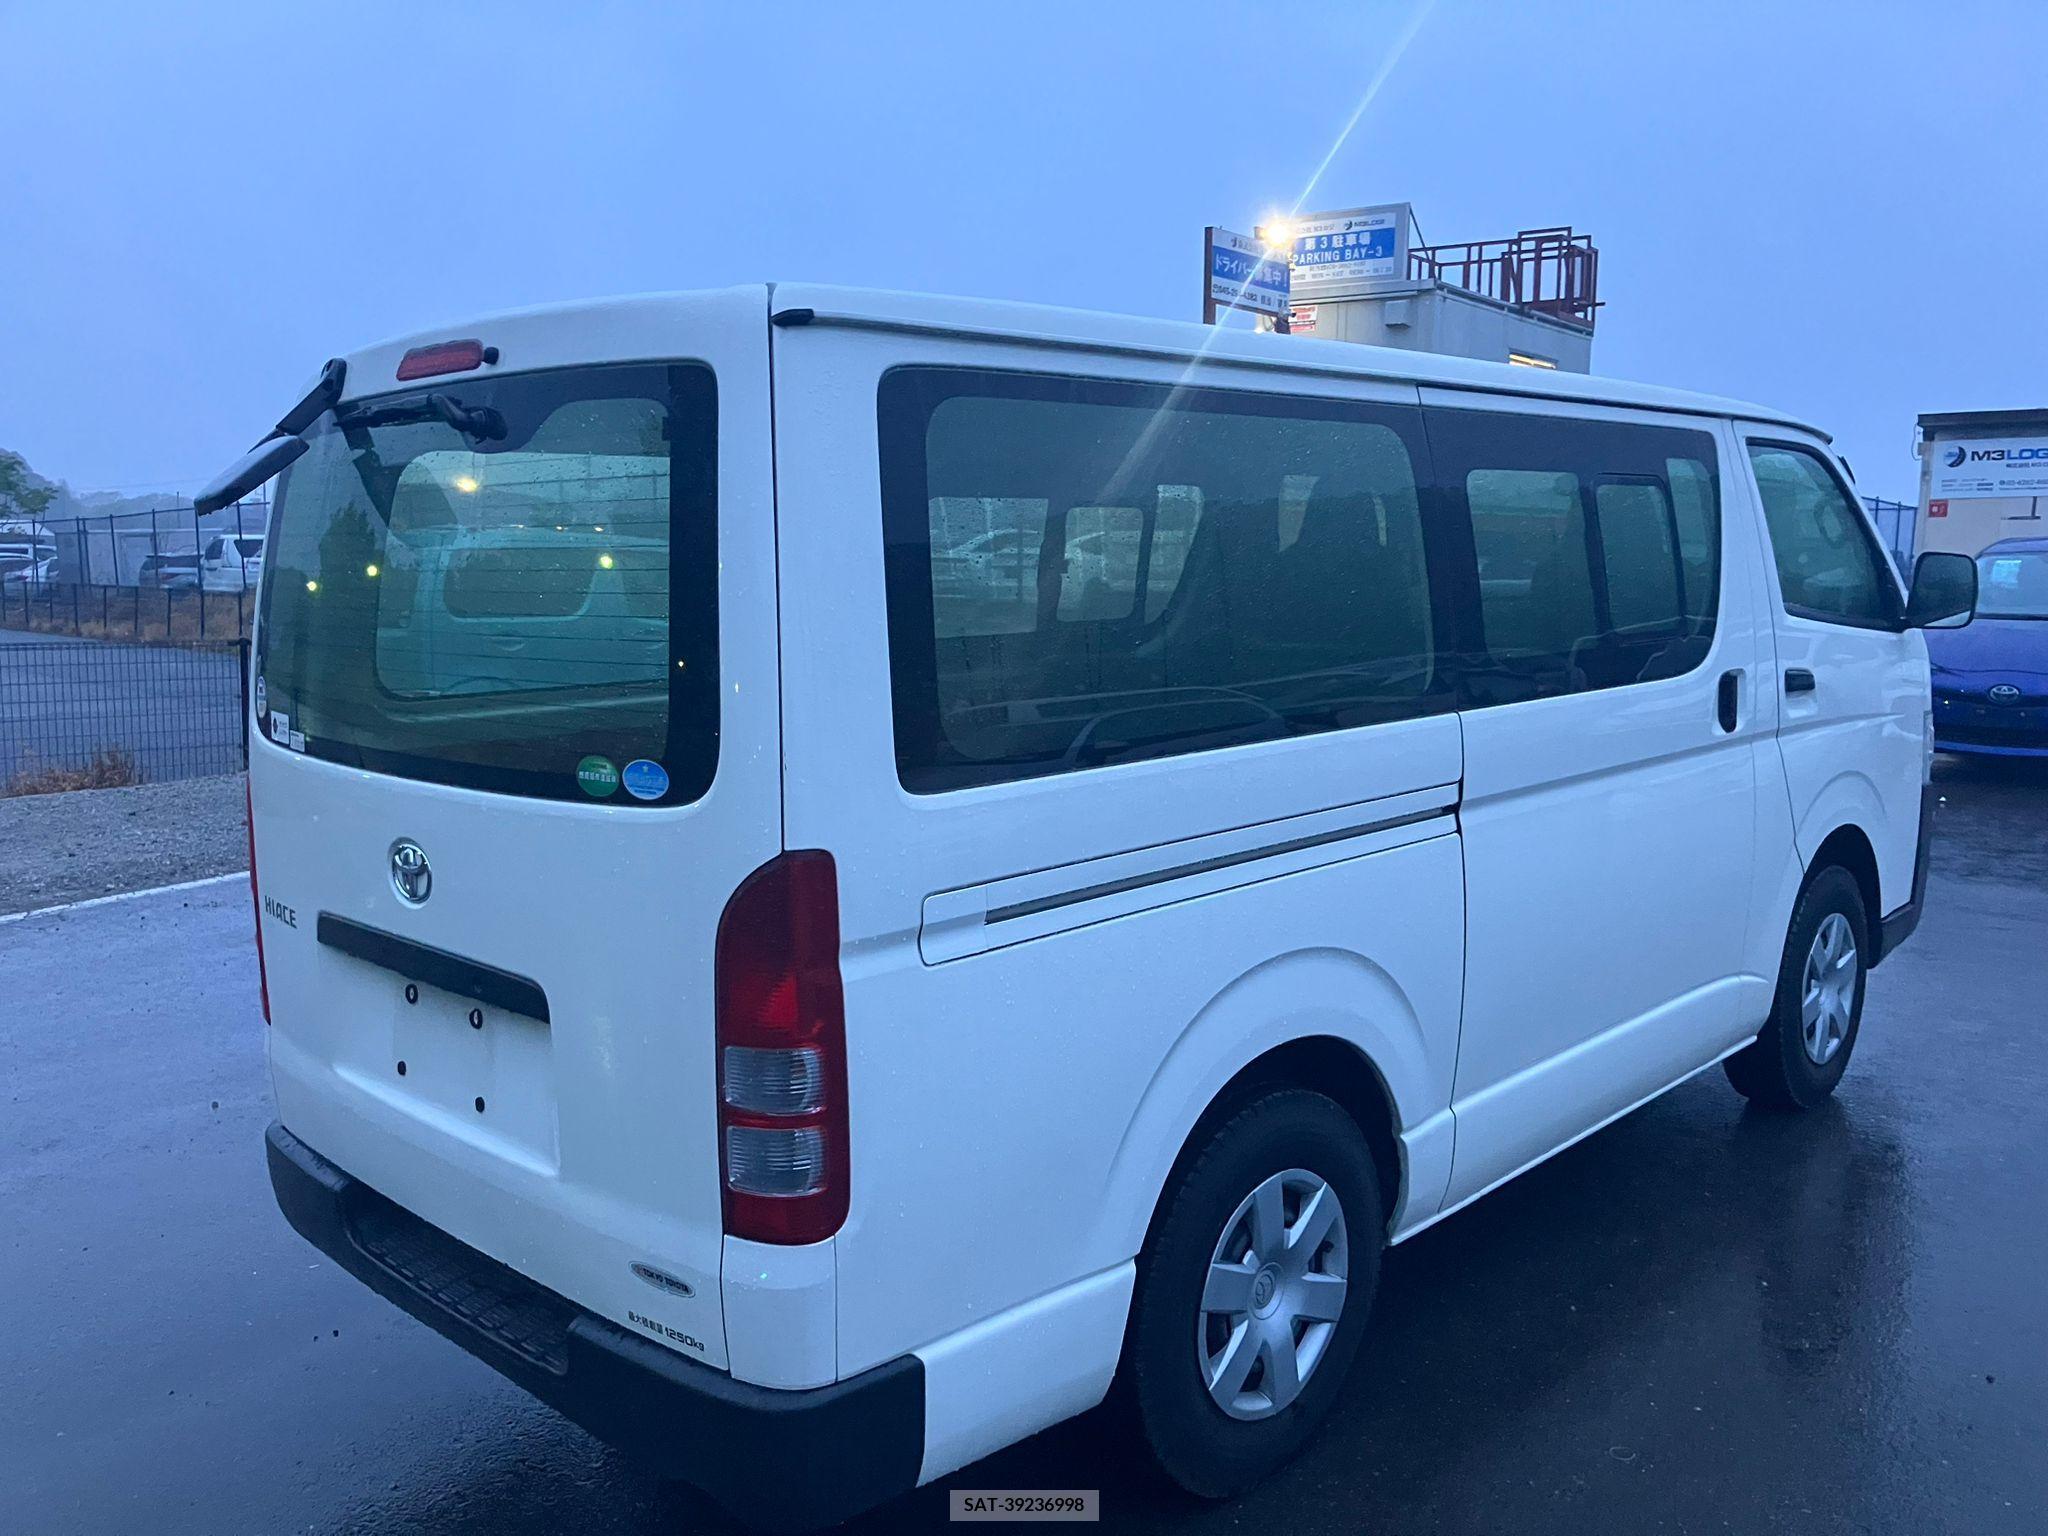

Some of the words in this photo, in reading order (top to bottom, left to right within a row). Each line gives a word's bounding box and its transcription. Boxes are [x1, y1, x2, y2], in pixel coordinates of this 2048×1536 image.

[1293, 251, 1340, 264] PARKING
[1345, 246, 1383, 260] BAY-3
[264, 895, 297, 929] HIACE
[664, 1277, 690, 1293] TOYOTA
[664, 1326, 705, 1352] 1250kg
